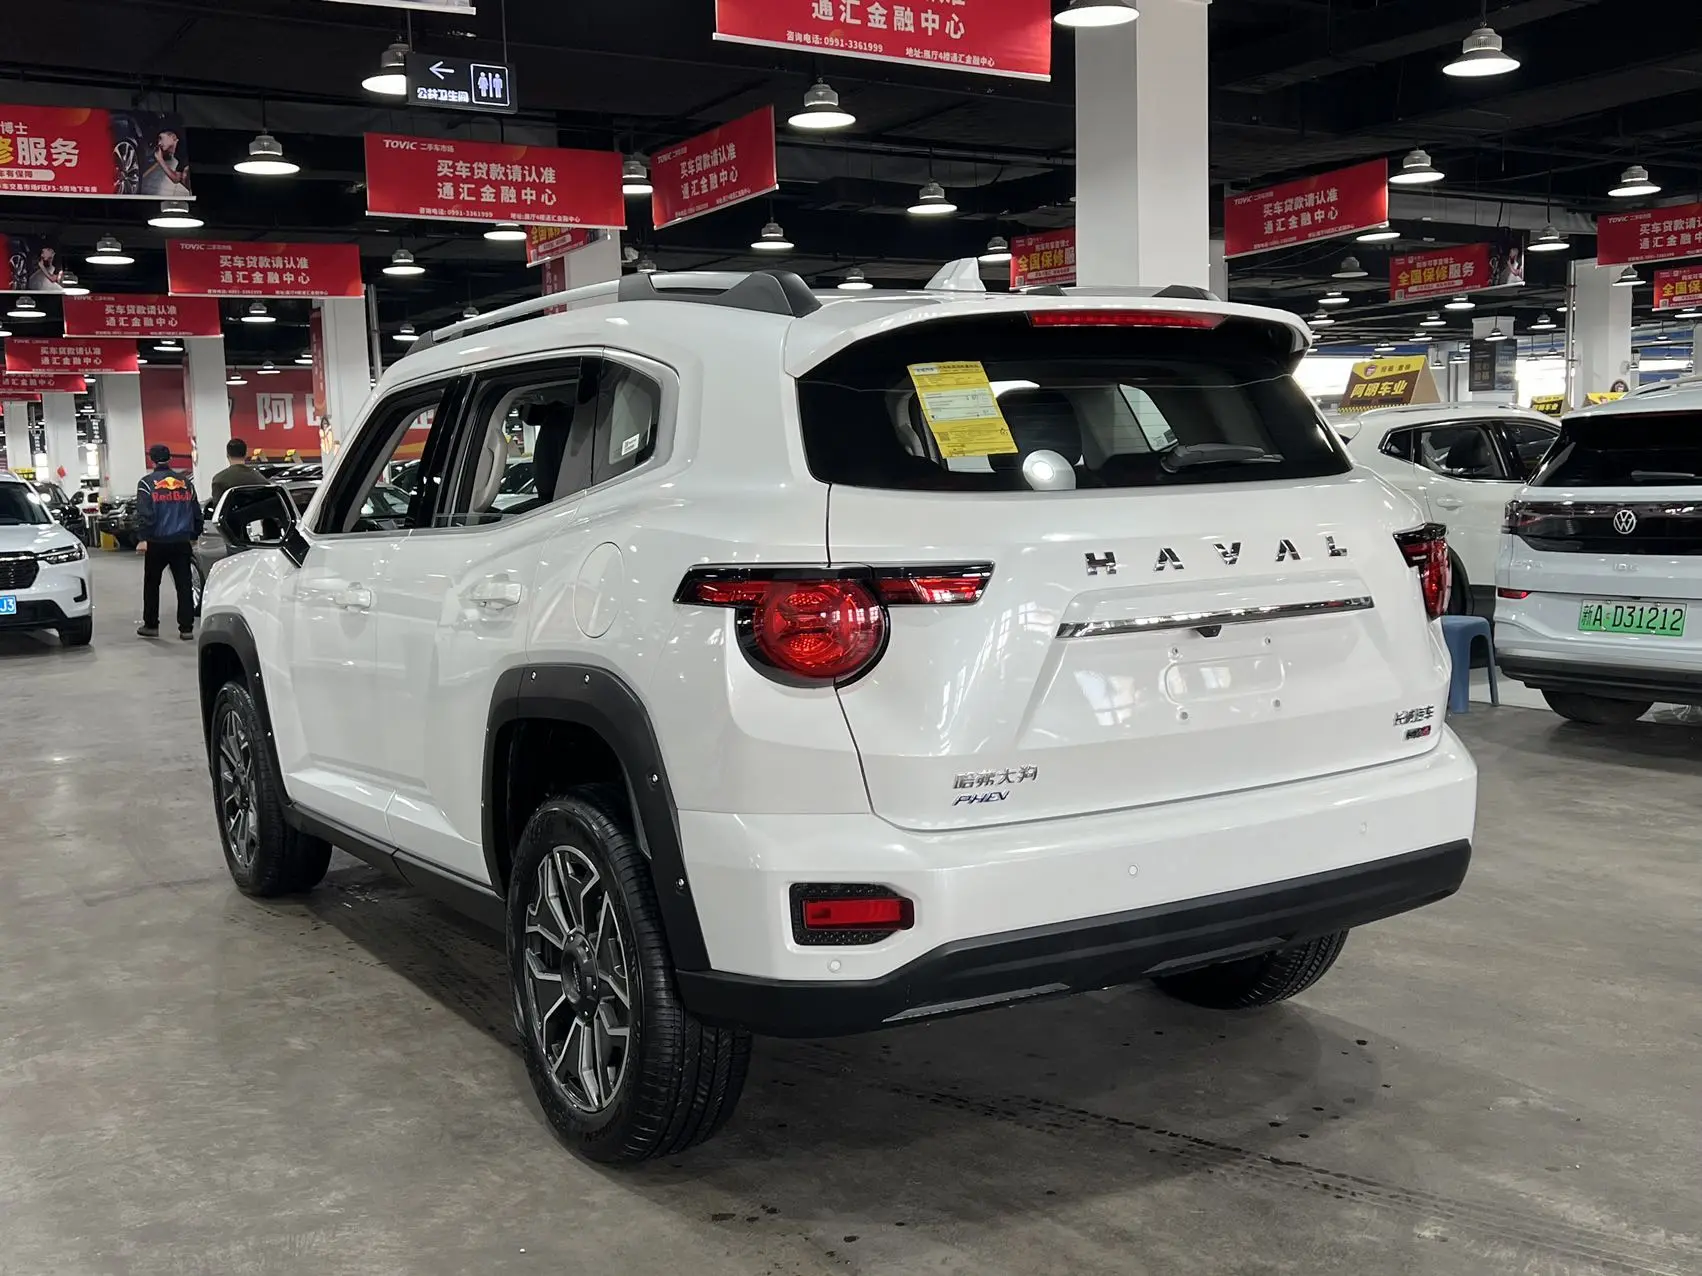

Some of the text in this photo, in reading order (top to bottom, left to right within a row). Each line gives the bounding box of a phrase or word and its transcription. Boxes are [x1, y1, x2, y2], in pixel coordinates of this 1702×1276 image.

[812, 0, 965, 39] 通汇金融中心
[786, 30, 884, 53] 咨询电话: 0991-3361999
[416, 87, 469, 103] 公共卫生间
[384, 139, 417, 150] TOVIC
[437, 159, 557, 184] 买车贷款请认准
[680, 142, 737, 180] 买车贷款请认准
[437, 182, 557, 206] 通汇金融中心
[681, 165, 739, 200] 通汇金融中心
[1263, 187, 1339, 218] 买车贷款请认准
[1263, 206, 1339, 235] 通汇金融中心
[219, 255, 310, 270] 买车贷款请认准
[1398, 261, 1475, 287] 全国保修服务
[220, 270, 311, 285] 通汇金融中心
[104, 304, 178, 315] 买车贷款请认准
[105, 316, 179, 327] 通汇金融中心
[1350, 380, 1408, 399] 阿明车业
[152, 491, 172, 503] Red
[1084, 534, 1348, 576] HAVAL
[952, 764, 1039, 790] 哈弗大狗
[951, 790, 1010, 806] PHEV
